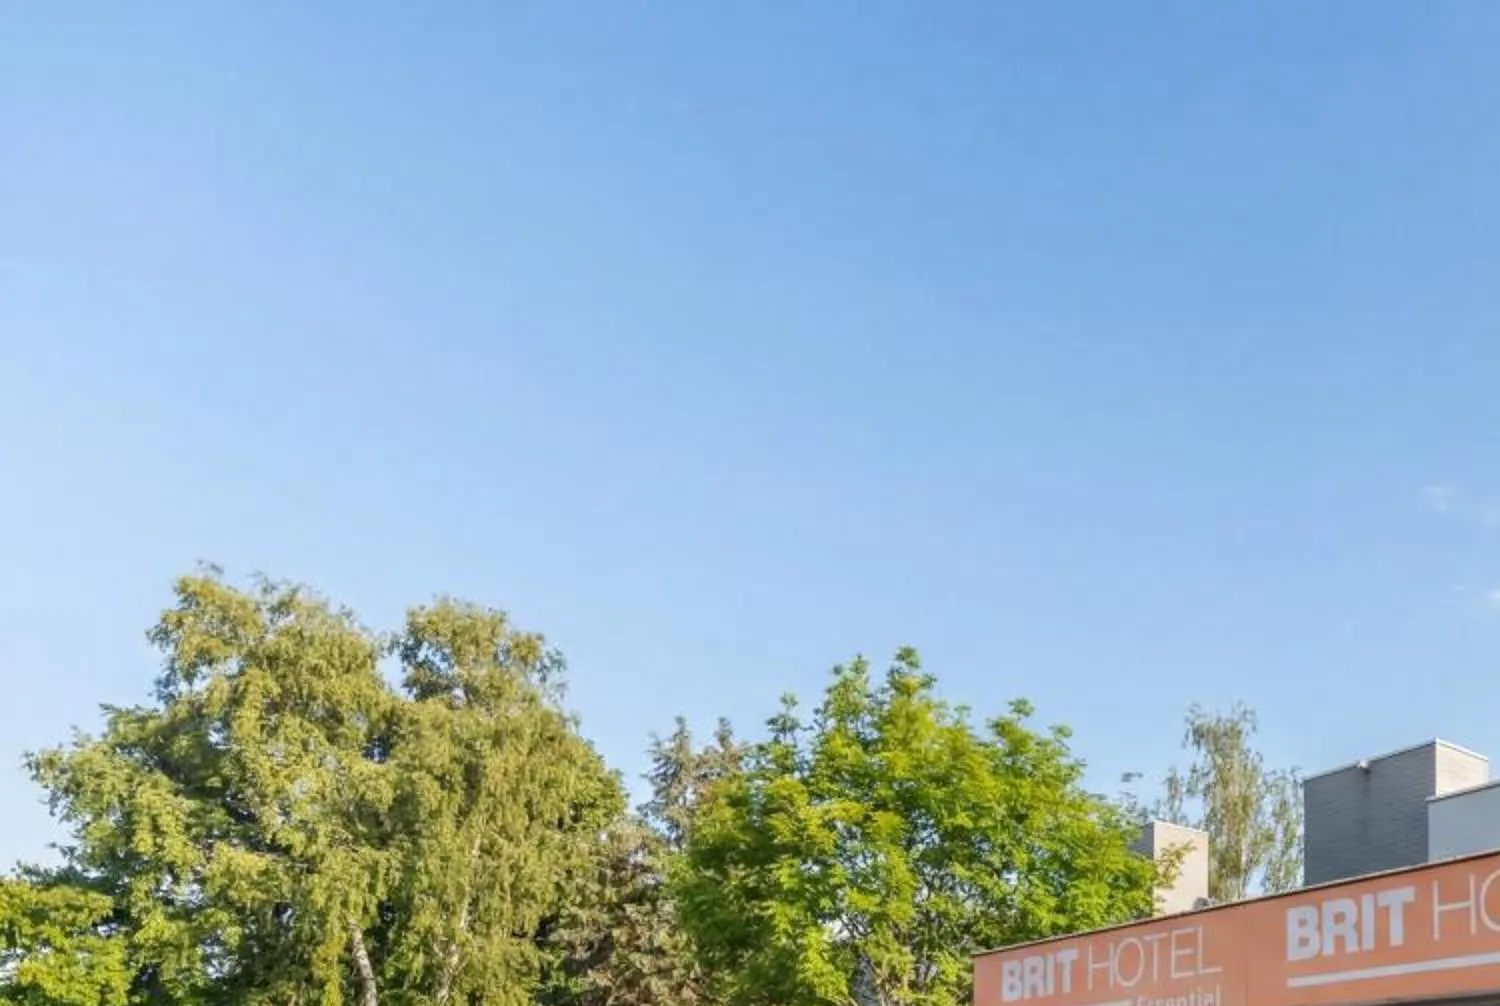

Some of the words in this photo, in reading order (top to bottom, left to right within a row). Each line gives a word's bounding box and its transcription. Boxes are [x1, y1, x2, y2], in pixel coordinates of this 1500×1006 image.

[1286, 886, 1417, 961] BRIT
[1001, 948, 1080, 1002] BRIT
[1086, 927, 1223, 988] HOTEL
